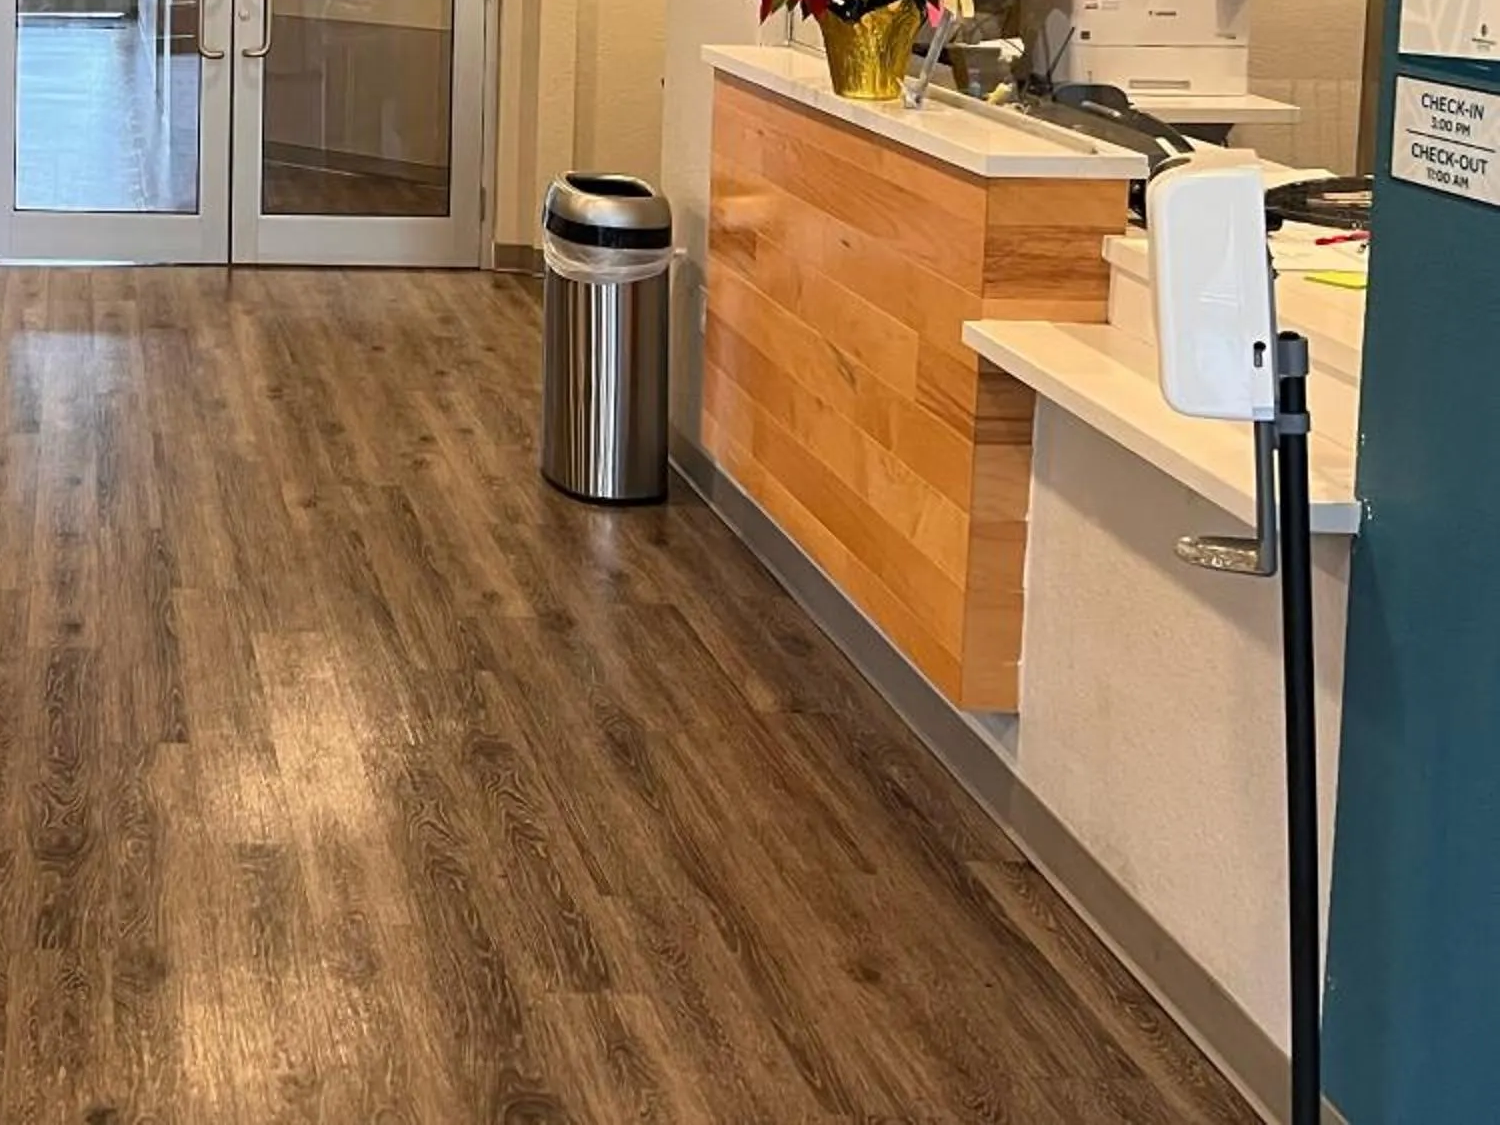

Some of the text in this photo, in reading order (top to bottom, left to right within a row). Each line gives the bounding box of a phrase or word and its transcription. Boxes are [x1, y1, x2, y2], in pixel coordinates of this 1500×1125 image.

[1420, 92, 1485, 121] CHECK-IN
[1430, 116, 1471, 136] 3:00 PM
[1411, 142, 1489, 175] CHECK-OUT
[1426, 166, 1469, 189] 11:00 AM
